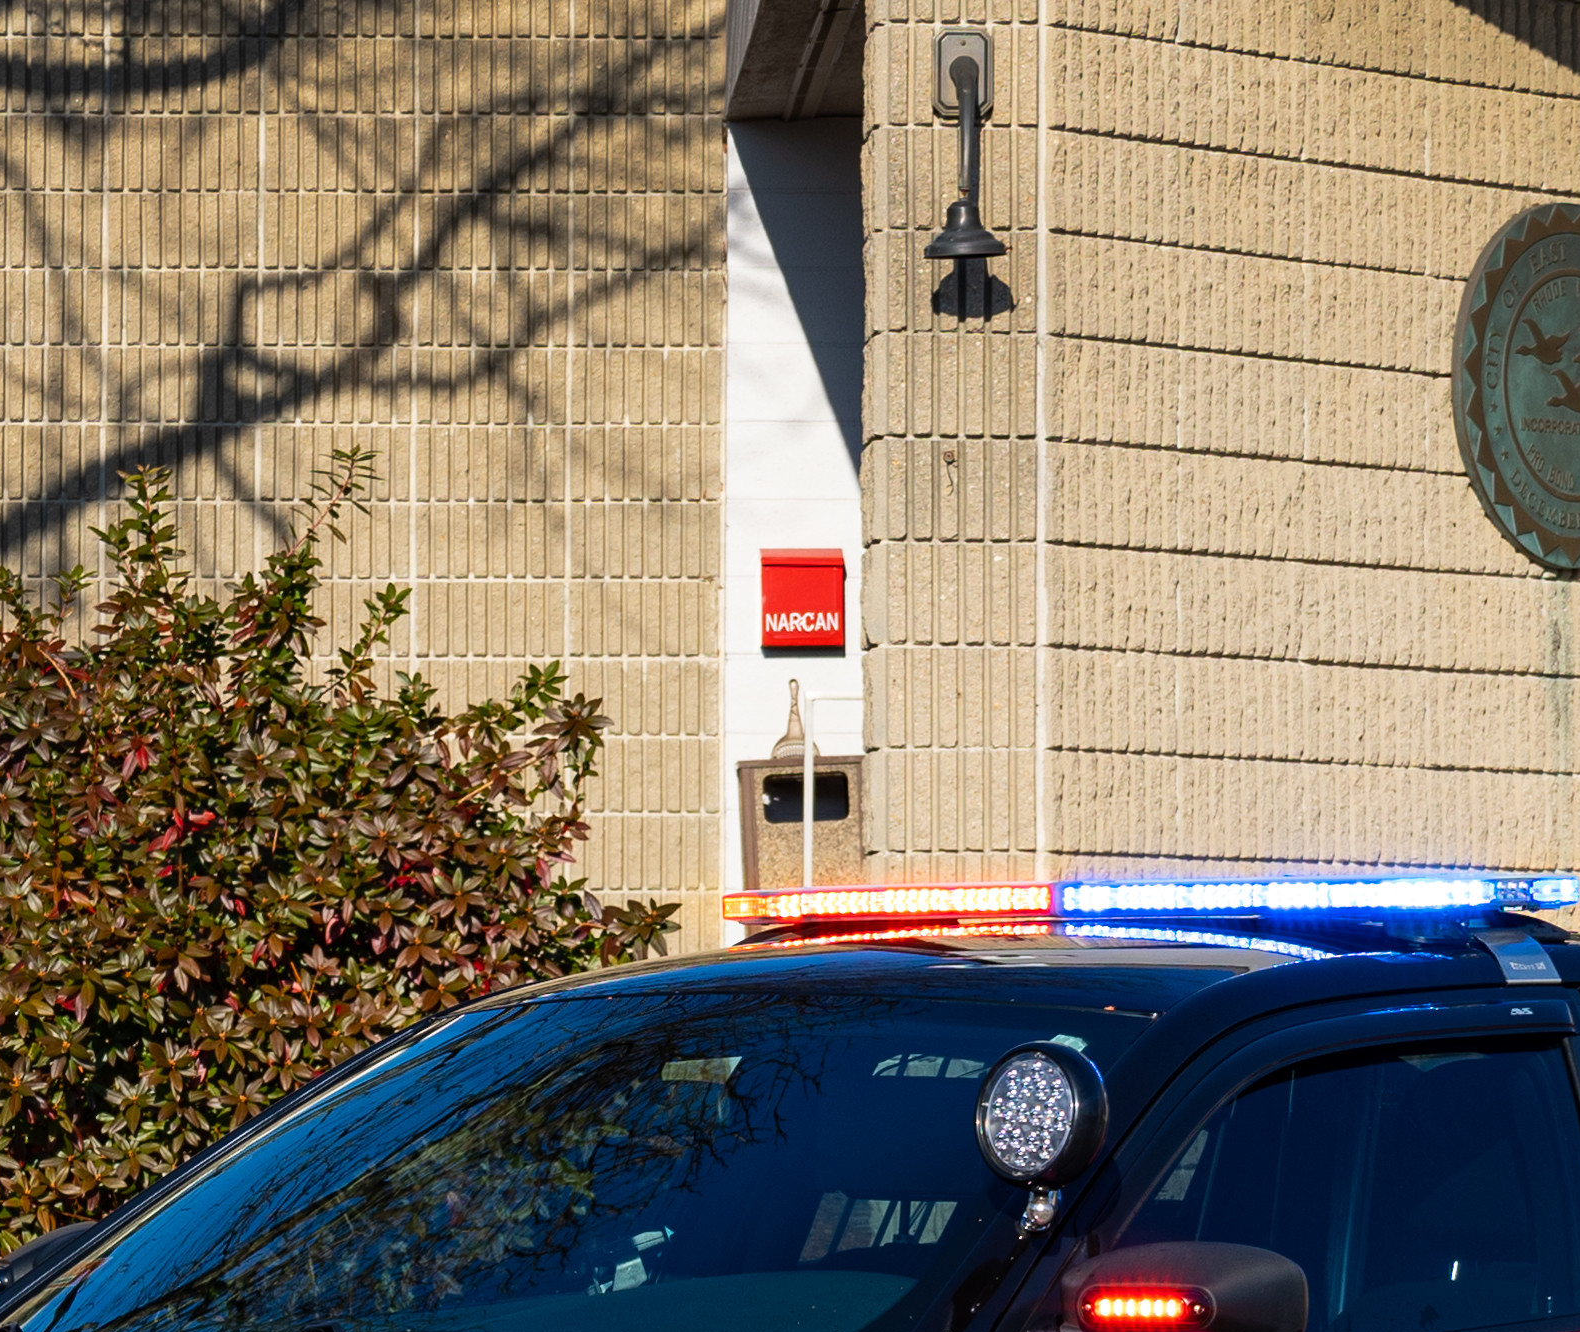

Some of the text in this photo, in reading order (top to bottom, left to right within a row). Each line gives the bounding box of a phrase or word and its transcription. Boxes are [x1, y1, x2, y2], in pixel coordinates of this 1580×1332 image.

[1486, 331, 1502, 390] CITY
[1501, 274, 1521, 309] OF
[1528, 241, 1567, 274] EAST
[1532, 280, 1567, 314] RHODE
[1526, 442, 1545, 473] PRO
[1547, 465, 1574, 491] BONO
[765, 612, 839, 632] NARCAN
